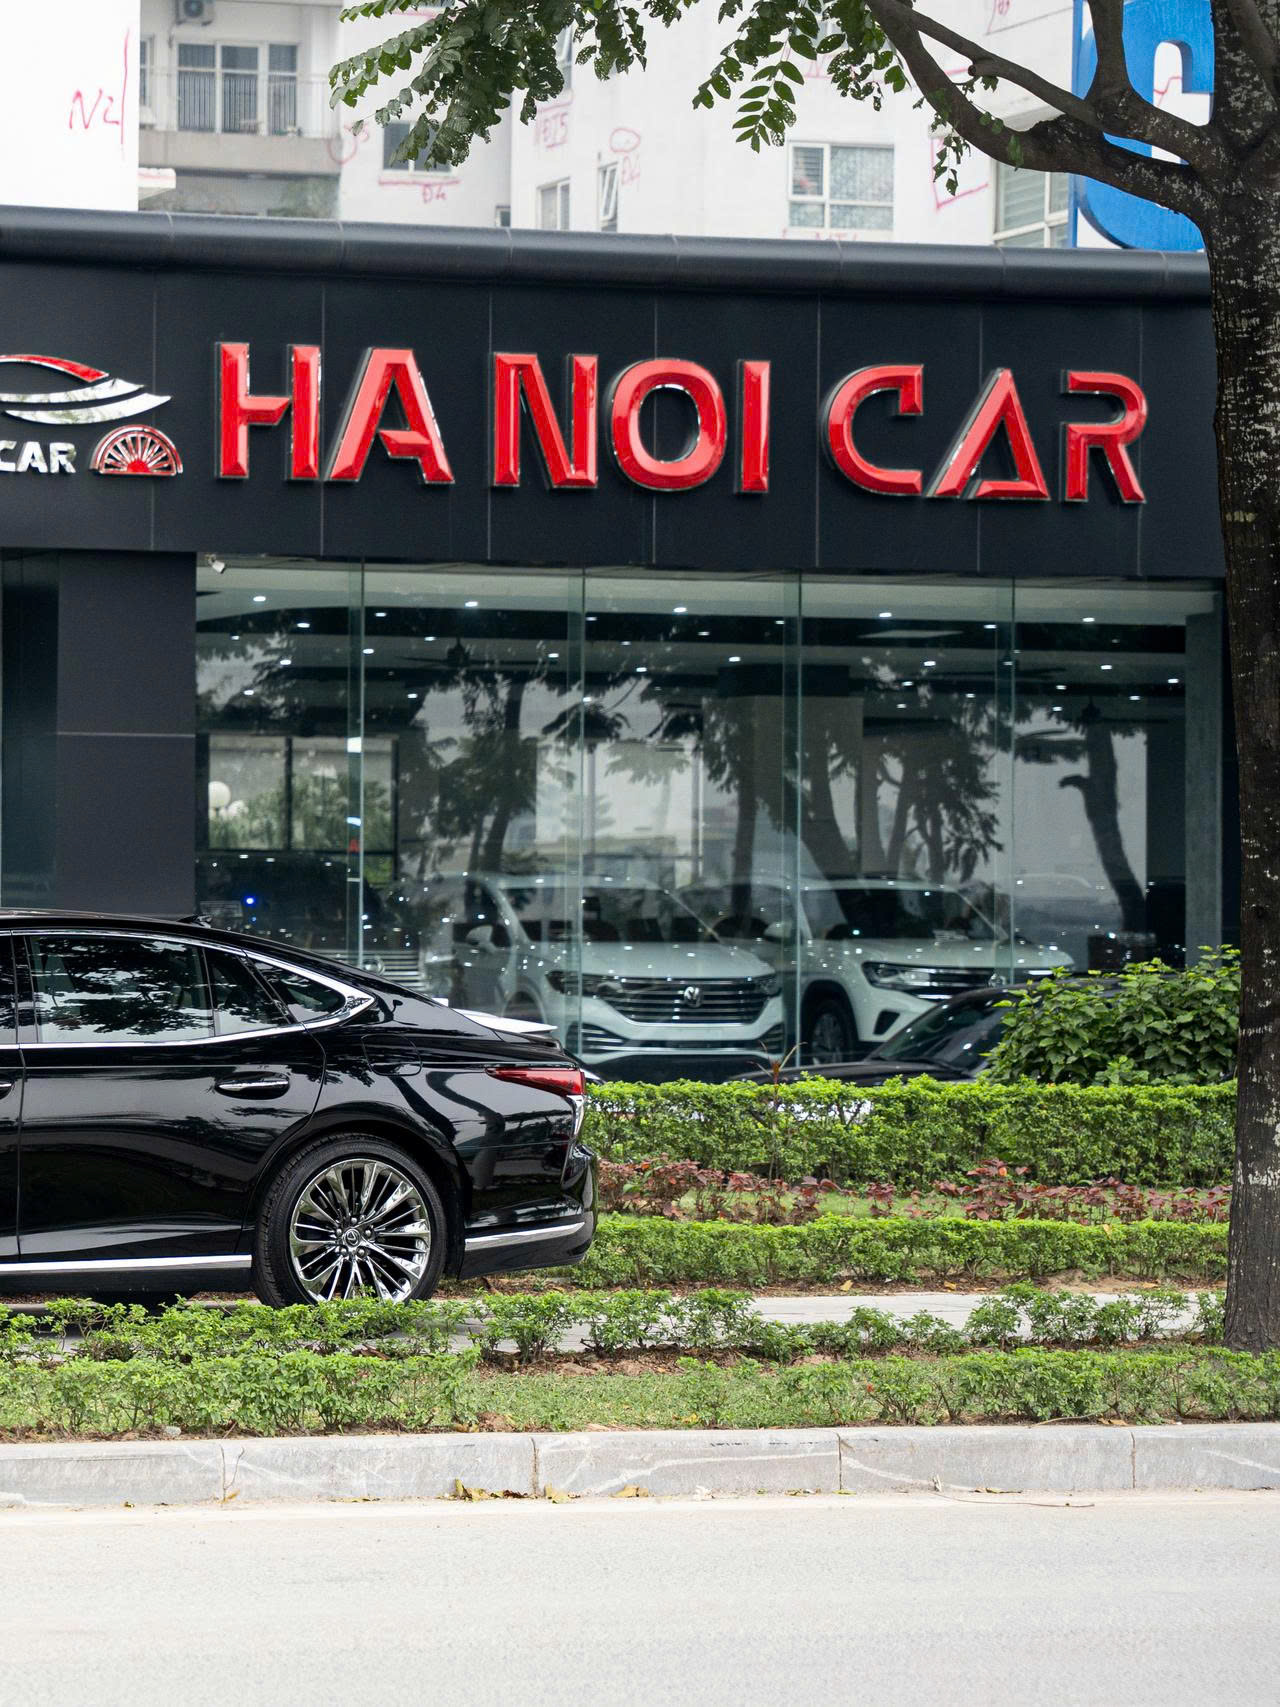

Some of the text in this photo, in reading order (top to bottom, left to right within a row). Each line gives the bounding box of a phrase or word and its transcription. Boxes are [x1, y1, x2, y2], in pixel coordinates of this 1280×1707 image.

[216, 341, 1148, 502] HA NOI CAR
